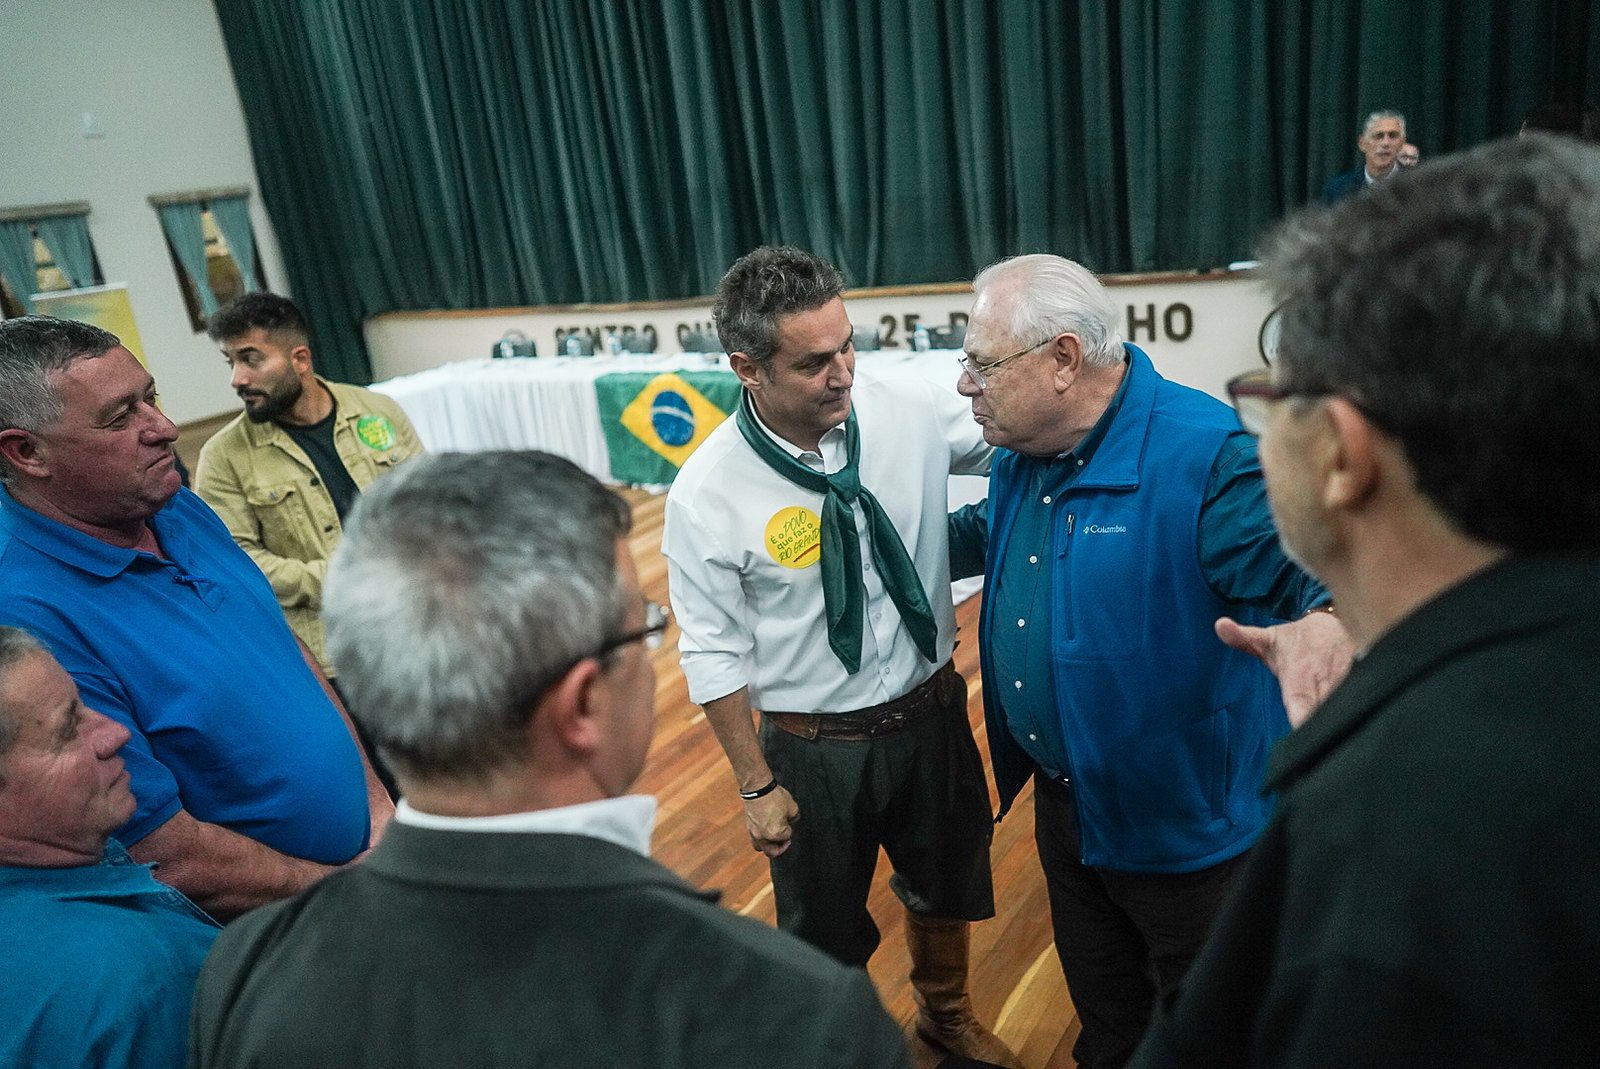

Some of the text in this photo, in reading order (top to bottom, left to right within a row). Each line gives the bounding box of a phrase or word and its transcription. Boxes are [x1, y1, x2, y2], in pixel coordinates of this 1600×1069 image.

[777, 536, 793, 551] que
[793, 527, 807, 538] faz
[793, 527, 820, 554] GRAND
[1090, 525, 1126, 533] Columbia
